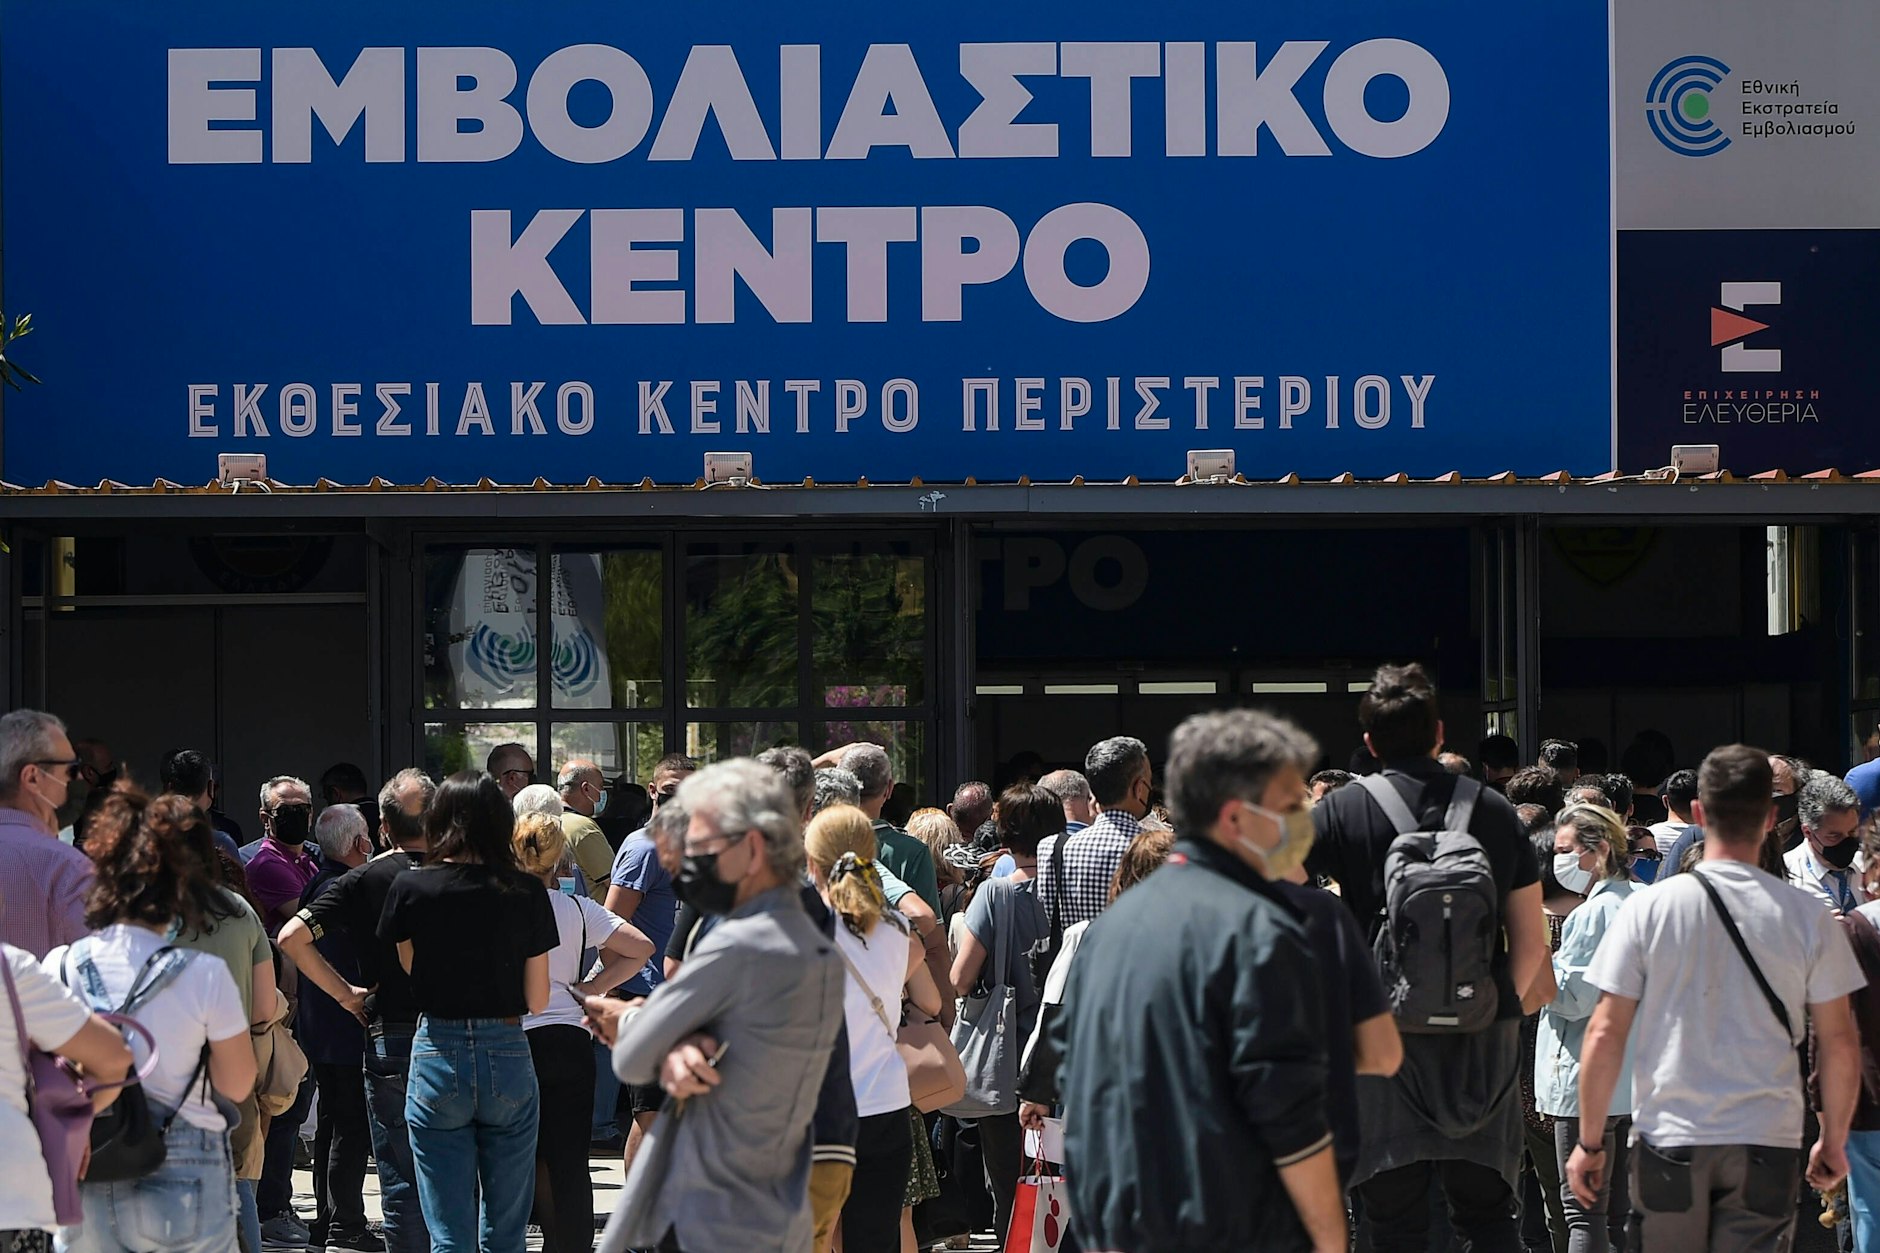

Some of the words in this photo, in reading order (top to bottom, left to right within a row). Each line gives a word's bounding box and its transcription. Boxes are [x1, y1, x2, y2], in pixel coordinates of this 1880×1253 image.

[1742, 79, 1800, 97] Εθνική
[167, 37, 1451, 165] ΕΜΒΟΛΙΑΣΤΙΚΟ
[1742, 100, 1838, 117] Εκστρατεία
[1742, 120, 1855, 138] Εμβολιασμού
[470, 202, 1151, 326] ΚΕΝΤΡΟ
[1683, 390, 1820, 400] ΕΠΙΧΕΙΡΗΣΗ
[187, 380, 595, 438] ΕΚΘΕΣΙΑΚΟ
[637, 378, 919, 435] ΚΕΝΤΡΟ
[961, 374, 1436, 432] ΠΕΡΙΣΤΕΡΙΟΥ
[1683, 403, 1819, 424] ΕΛΕΥΘΕΡΙΑ
